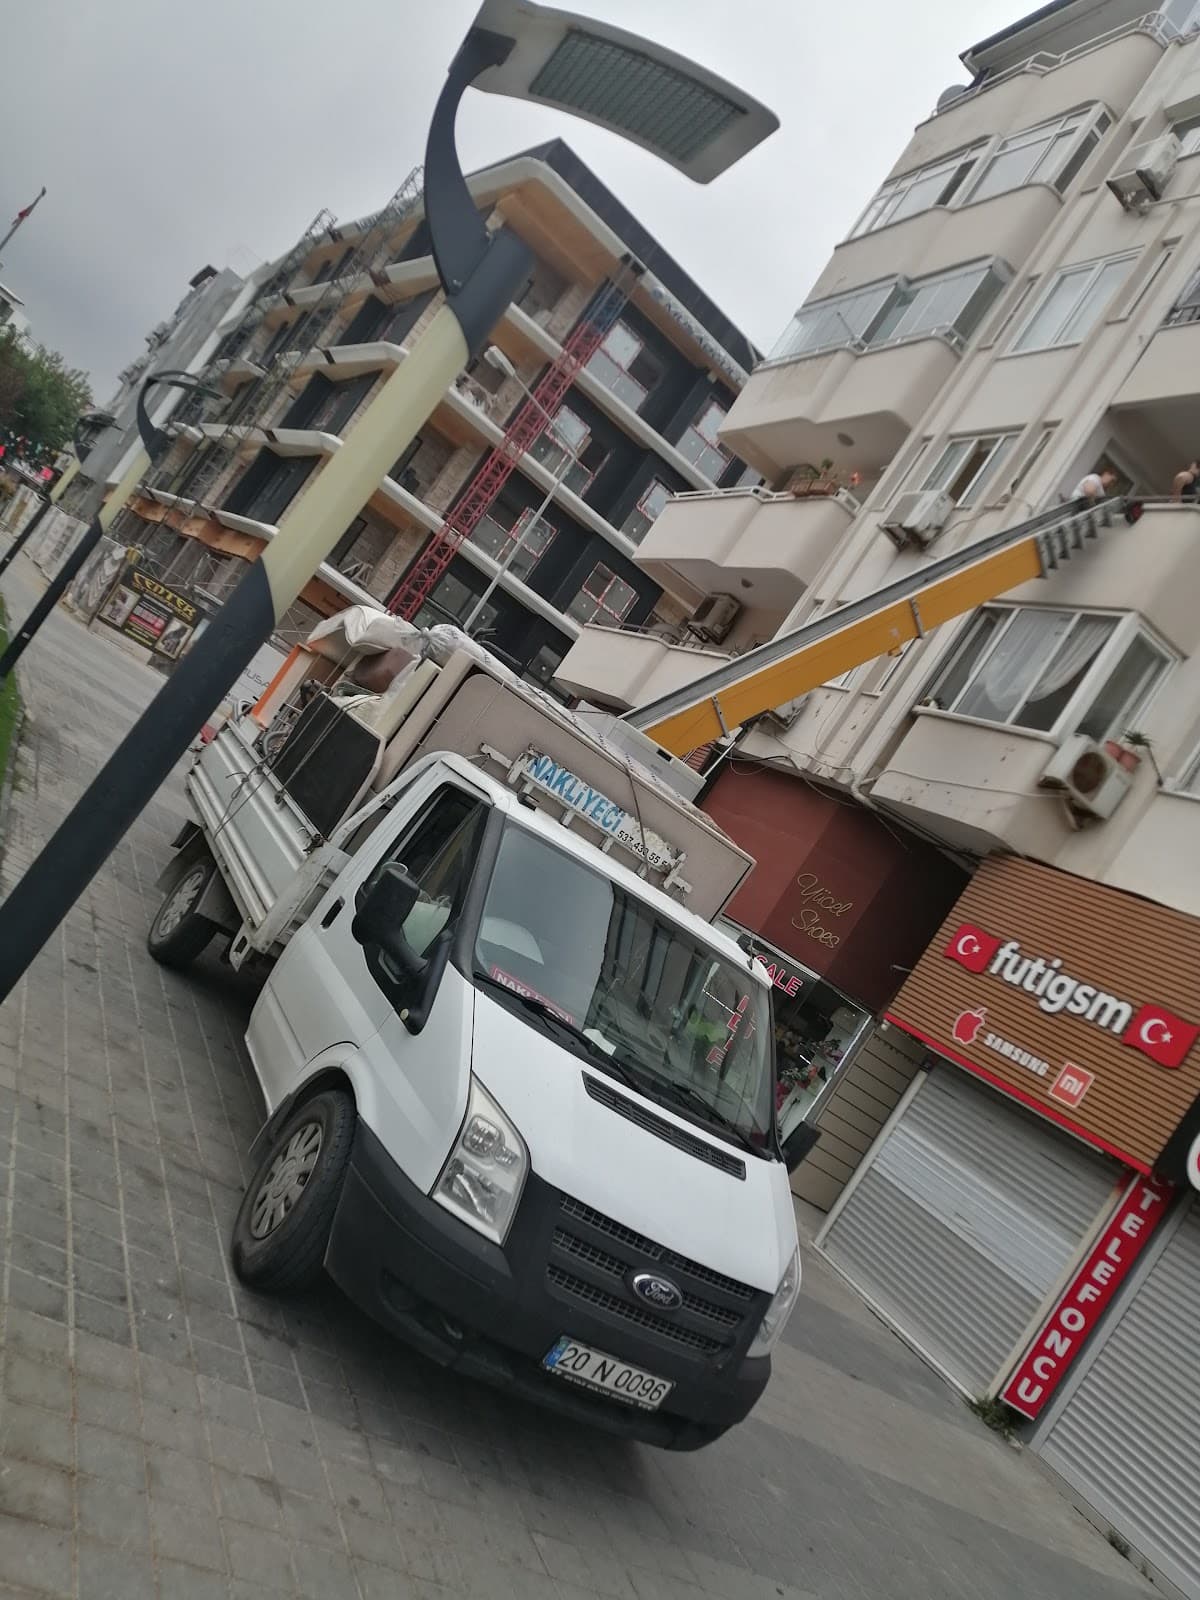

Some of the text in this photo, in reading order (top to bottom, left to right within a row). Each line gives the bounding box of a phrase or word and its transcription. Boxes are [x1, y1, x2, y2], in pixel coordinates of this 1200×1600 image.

[648, 853, 660, 864] 55
[791, 908, 840, 949] Shoes
[989, 941, 1133, 1034] futigsm
[984, 1032, 1050, 1076] SAMSUNG
[645, 1281, 675, 1305] Ford
[1017, 1187, 1161, 1404] TELEFONCU
[558, 1347, 591, 1371] 20
[591, 1360, 616, 1382] N
[614, 1369, 666, 1401] 0096
